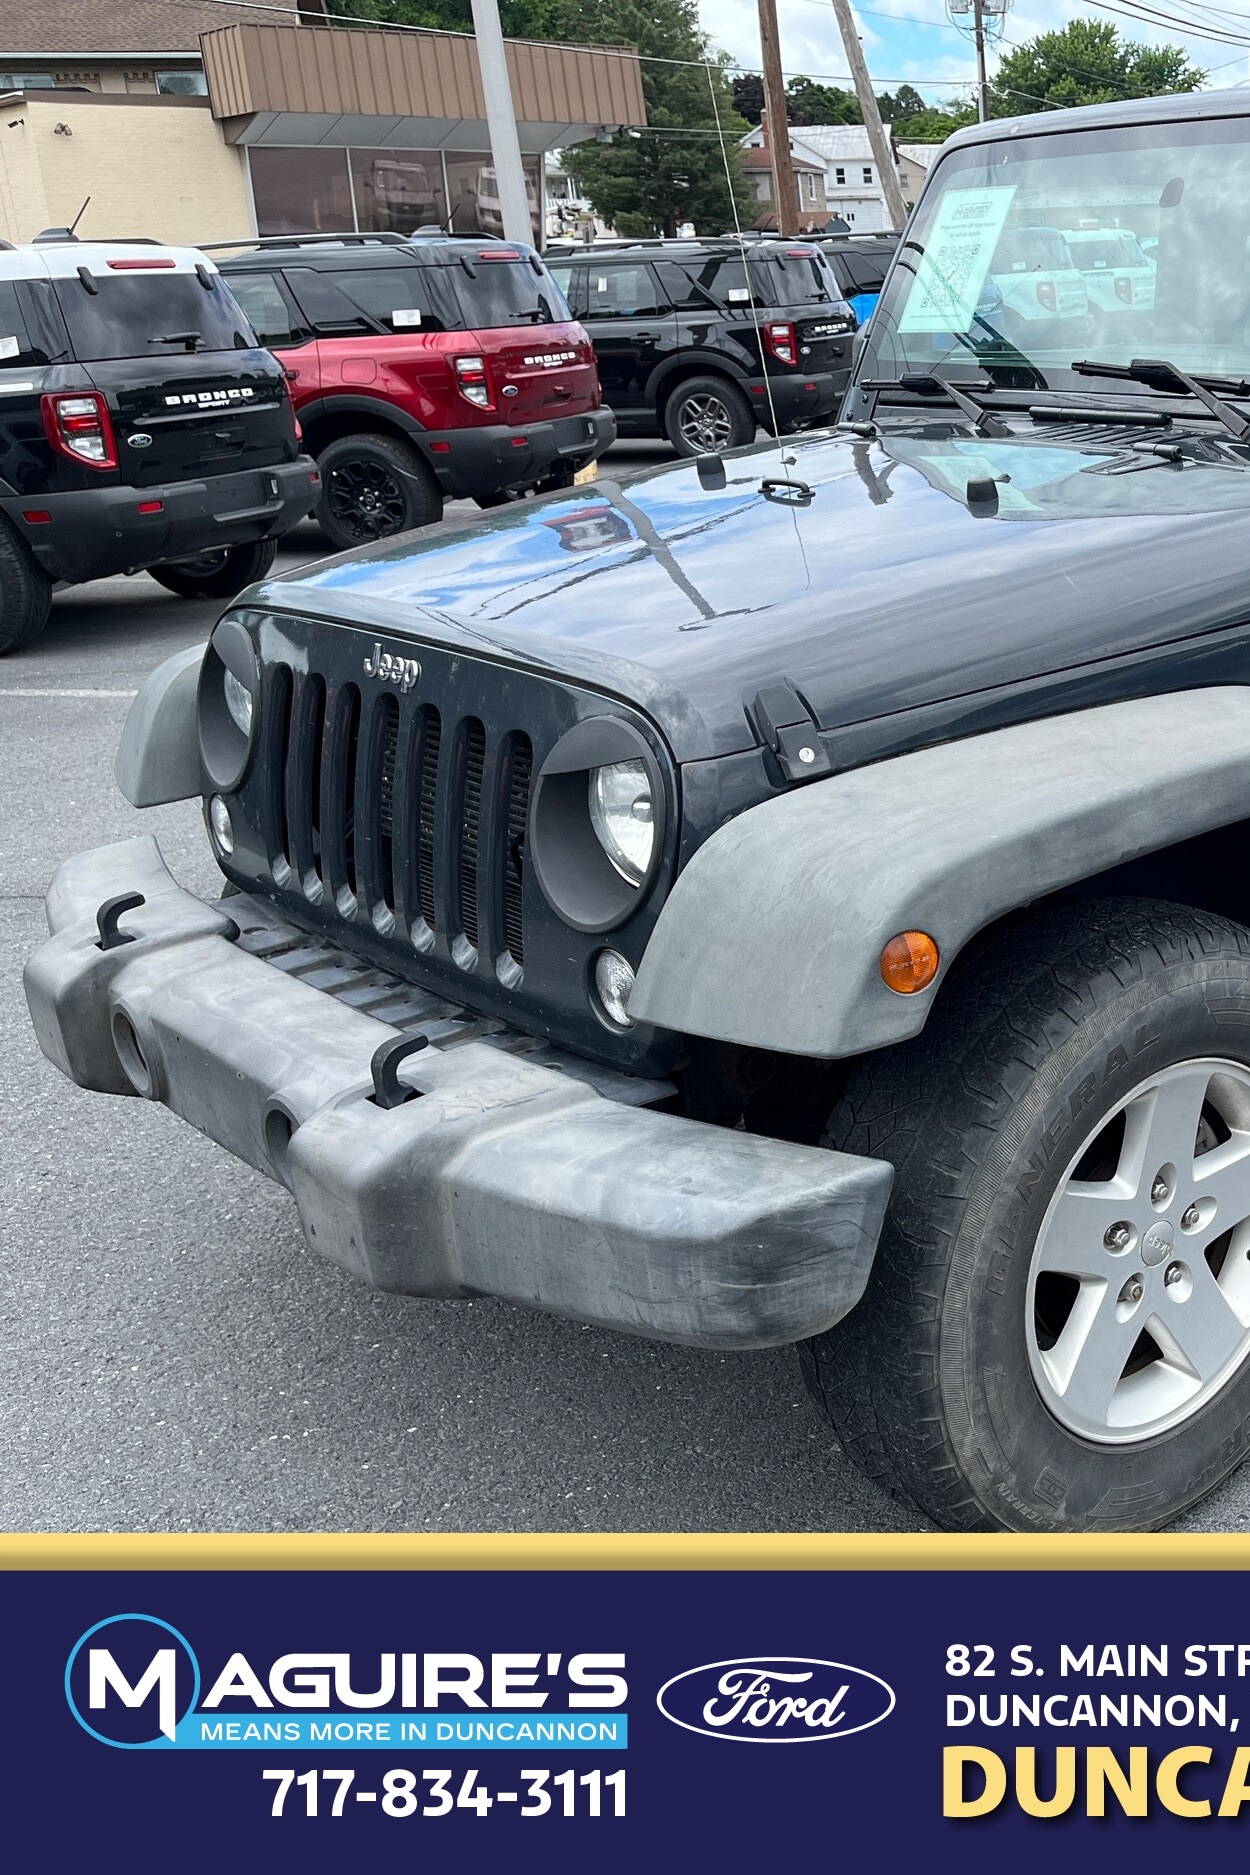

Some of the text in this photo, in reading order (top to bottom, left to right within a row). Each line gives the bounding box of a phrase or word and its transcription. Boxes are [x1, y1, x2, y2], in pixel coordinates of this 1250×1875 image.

[523, 351, 576, 365] BRONCO
[165, 387, 254, 406] BRONCO
[198, 400, 230, 409] SPORT
[363, 642, 422, 694] Jeep
